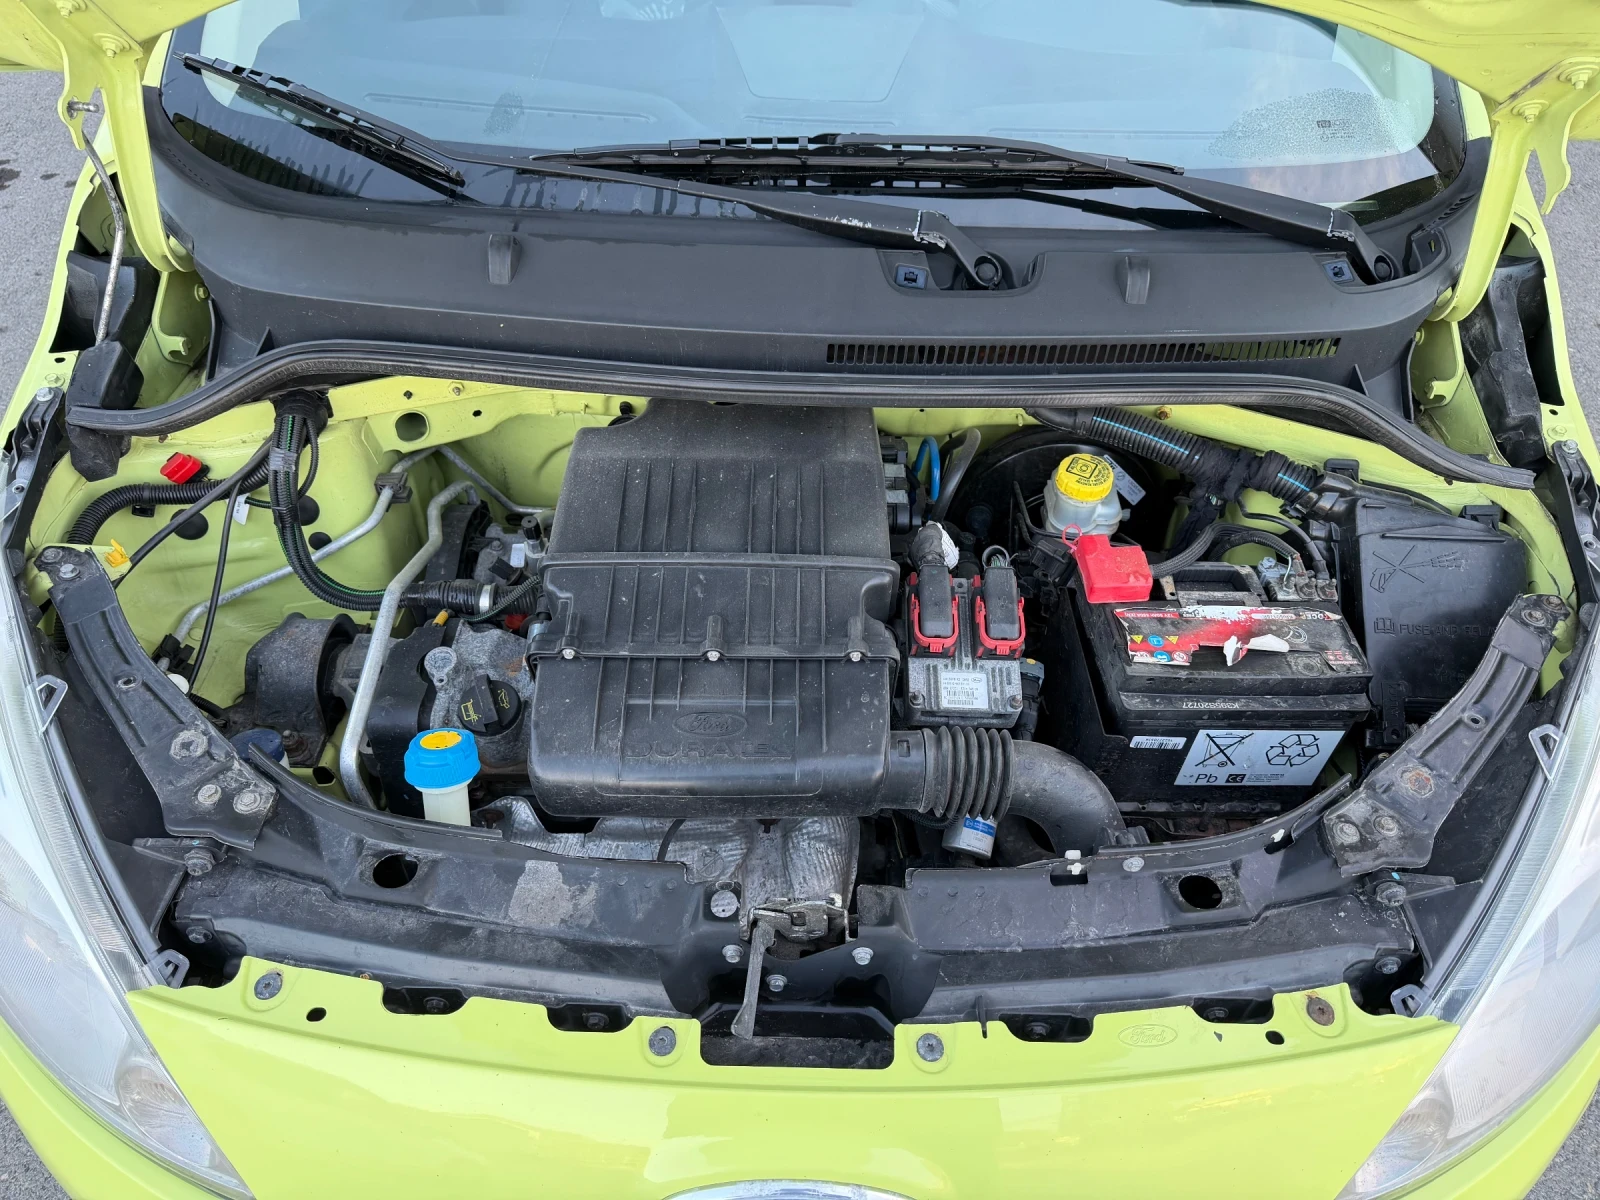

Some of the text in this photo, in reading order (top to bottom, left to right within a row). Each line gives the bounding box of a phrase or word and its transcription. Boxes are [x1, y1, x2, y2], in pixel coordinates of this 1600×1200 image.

[1399, 623, 1431, 636] FUSE
[689, 714, 733, 732] Ford
[1194, 773, 1218, 784] Pb
[1130, 1027, 1166, 1044] Ford
